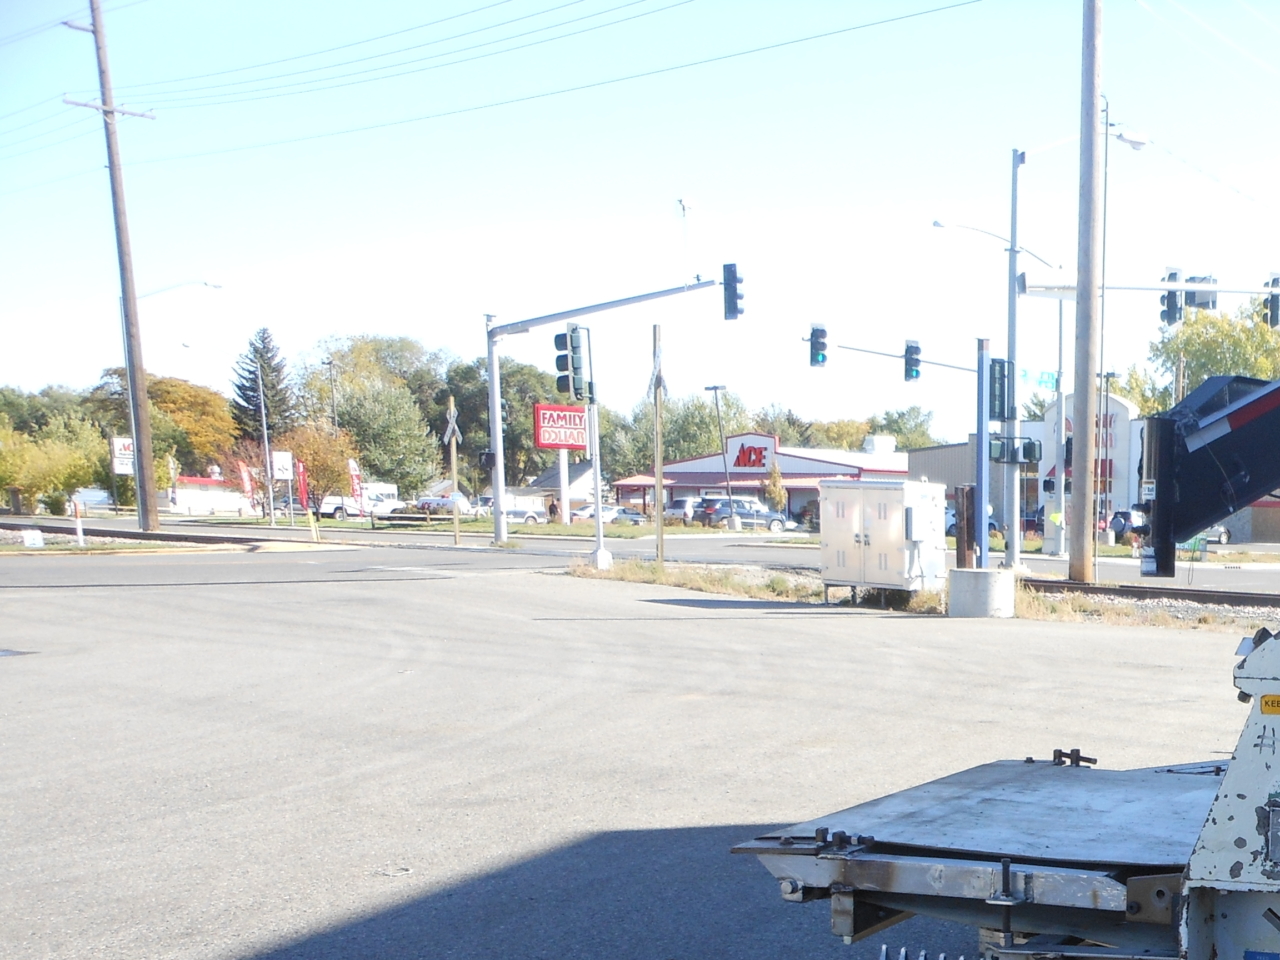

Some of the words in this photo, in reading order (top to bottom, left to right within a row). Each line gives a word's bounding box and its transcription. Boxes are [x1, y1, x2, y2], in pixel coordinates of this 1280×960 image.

[541, 411, 585, 427] FAMILY
[541, 428, 586, 445] DOLLAR
[733, 442, 768, 467] ACE
